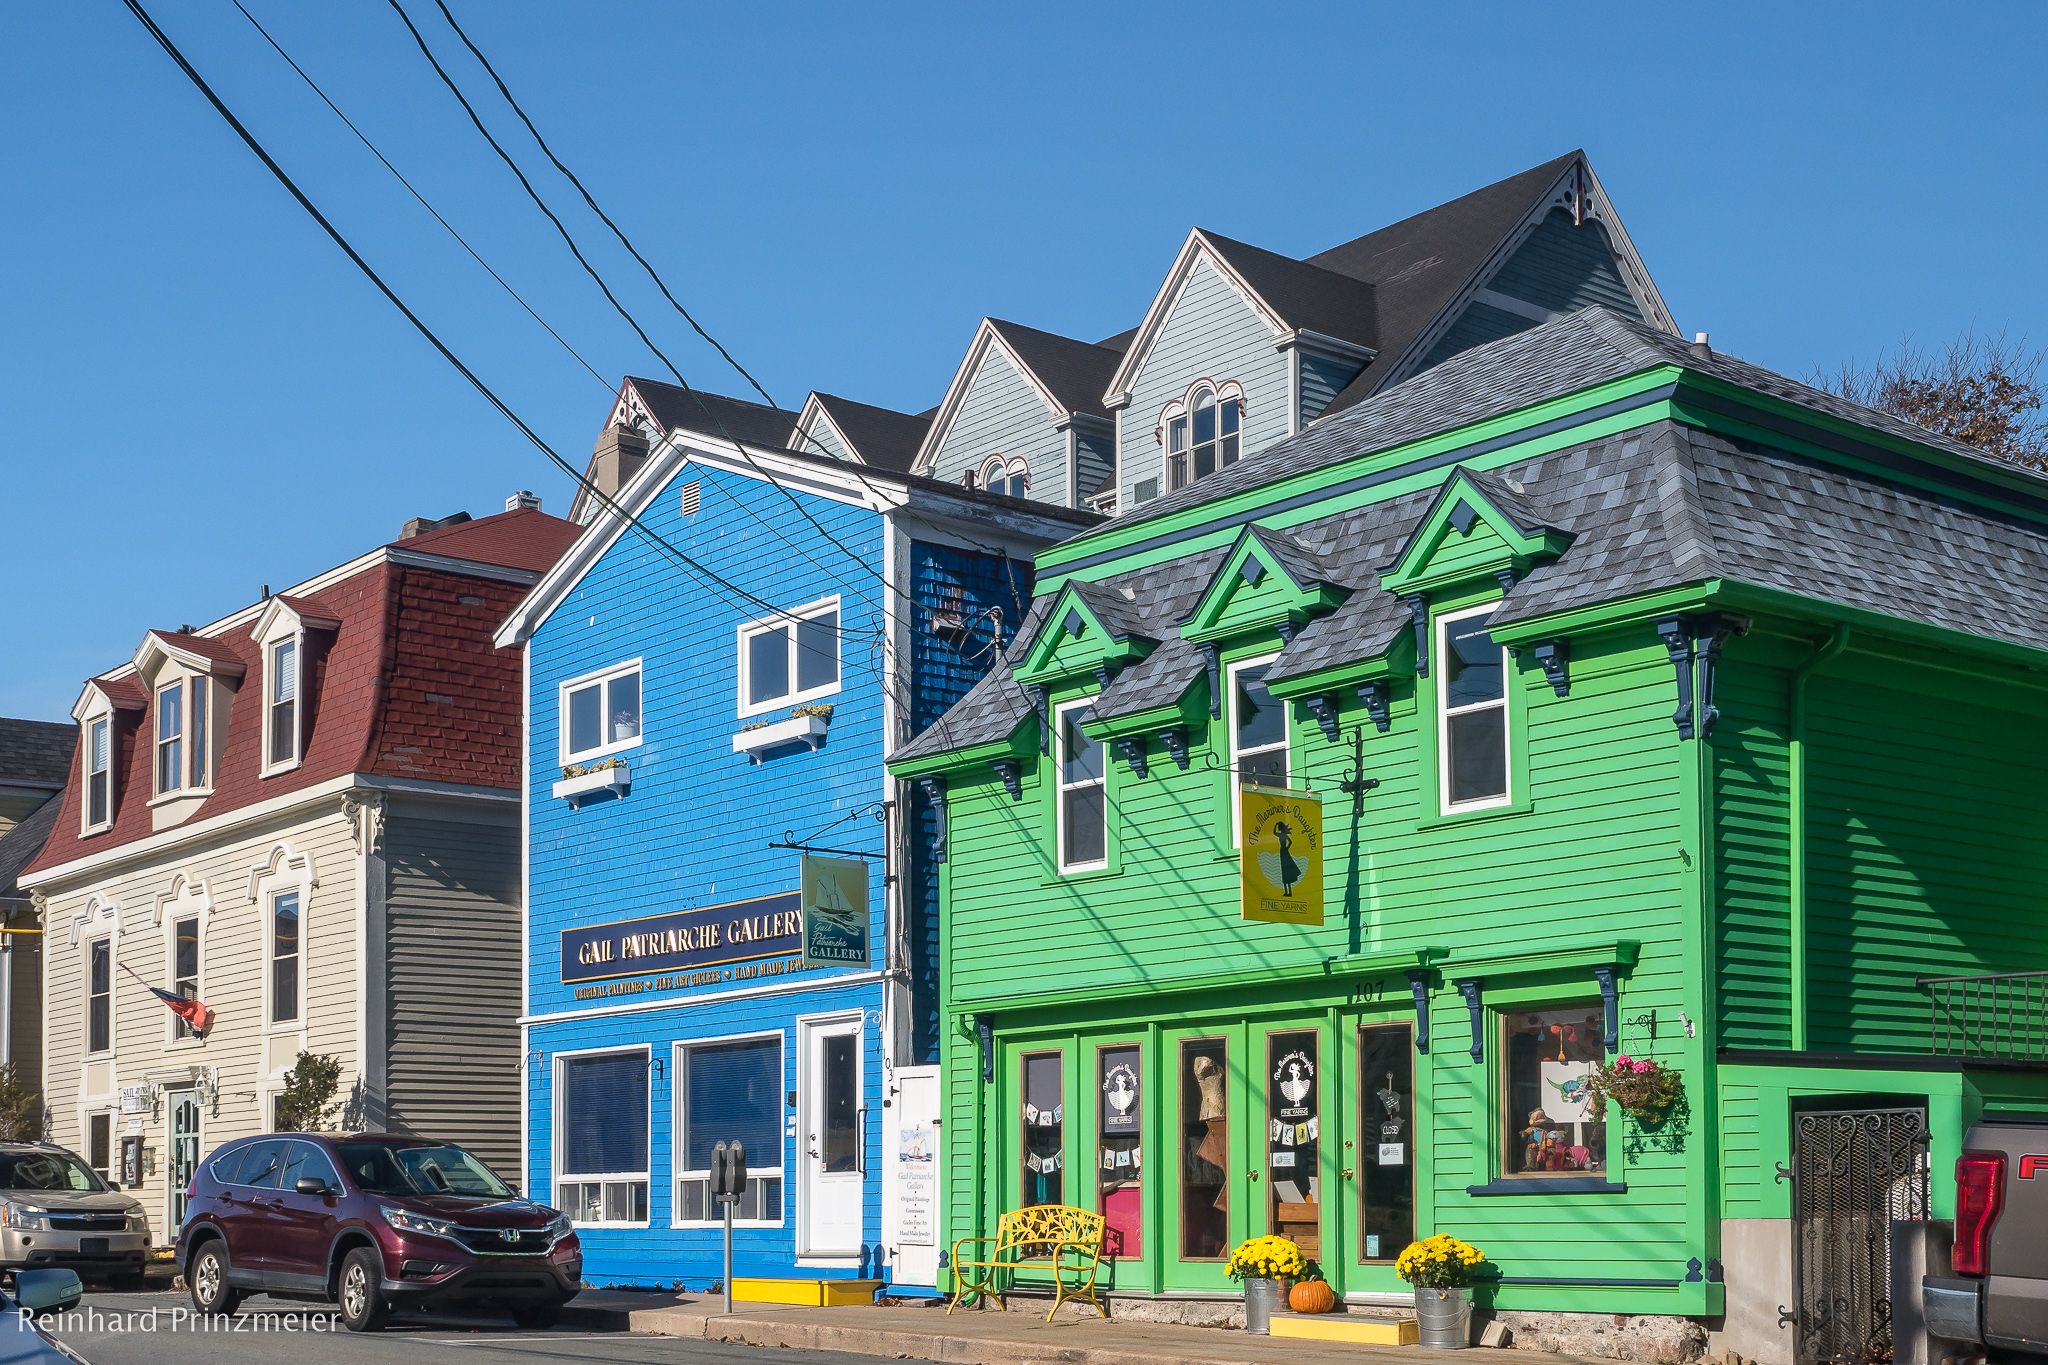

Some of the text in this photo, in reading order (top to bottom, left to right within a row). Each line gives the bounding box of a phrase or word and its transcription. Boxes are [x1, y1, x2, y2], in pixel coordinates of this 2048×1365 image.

[1248, 825, 1262, 845] The
[1293, 805, 1317, 850] Daughter
[1260, 899, 1308, 913] FINE YARNS
[814, 922, 833, 933] Gail
[579, 939, 616, 965] GAIL
[621, 923, 721, 959] PATRIARCHE
[810, 946, 864, 960] GALLERY
[574, 985, 607, 1000] ORIGINAL
[608, 980, 644, 997] PAINTINGS
[655, 976, 673, 990] FINE
[674, 974, 689, 988] ART
[735, 964, 757, 979] HAND
[760, 961, 784, 976] MADE
[1356, 979, 1385, 1002] 107
